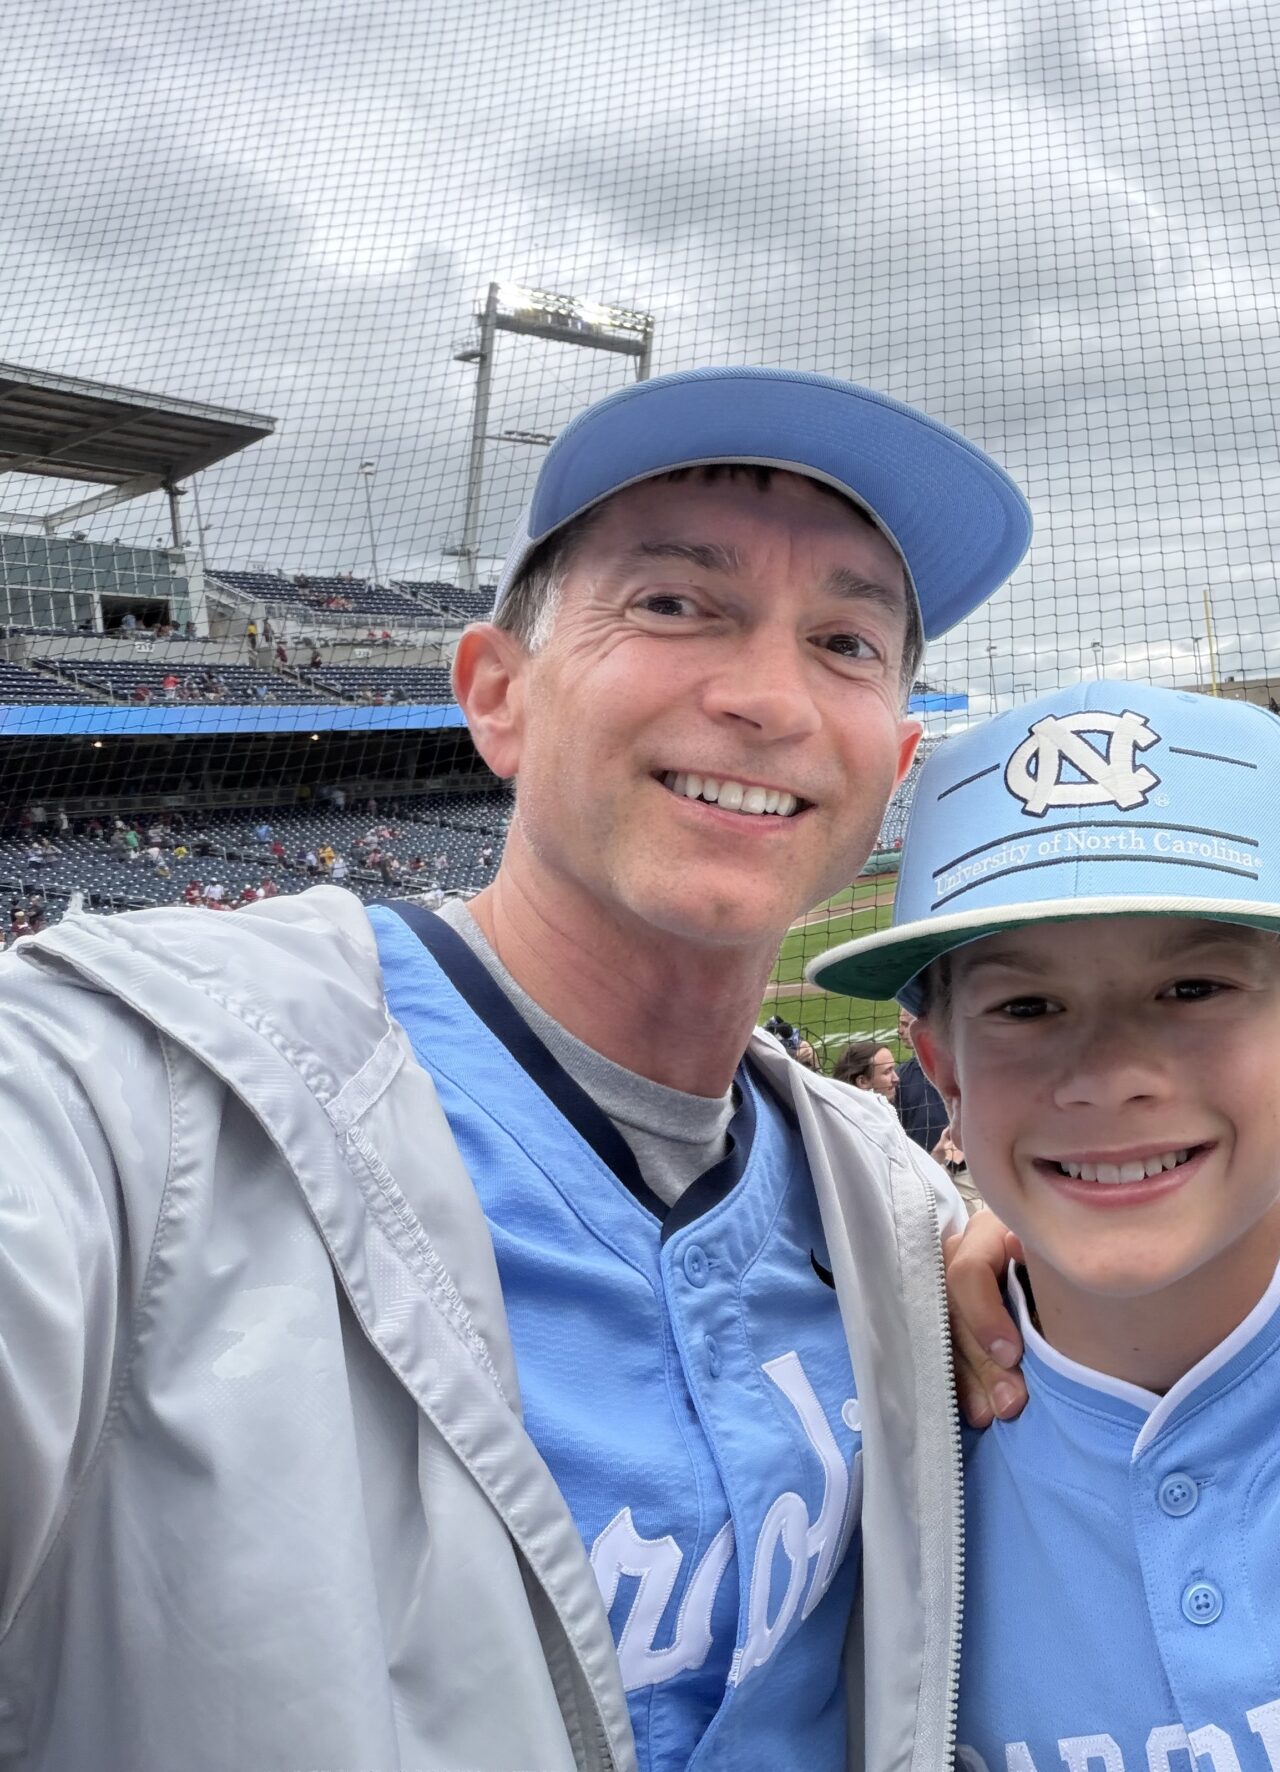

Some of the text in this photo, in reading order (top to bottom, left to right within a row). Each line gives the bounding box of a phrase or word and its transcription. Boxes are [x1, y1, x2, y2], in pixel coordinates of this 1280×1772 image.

[934, 844, 1031, 896] University
[1038, 832, 1062, 856] of
[1063, 829, 1145, 852] North
